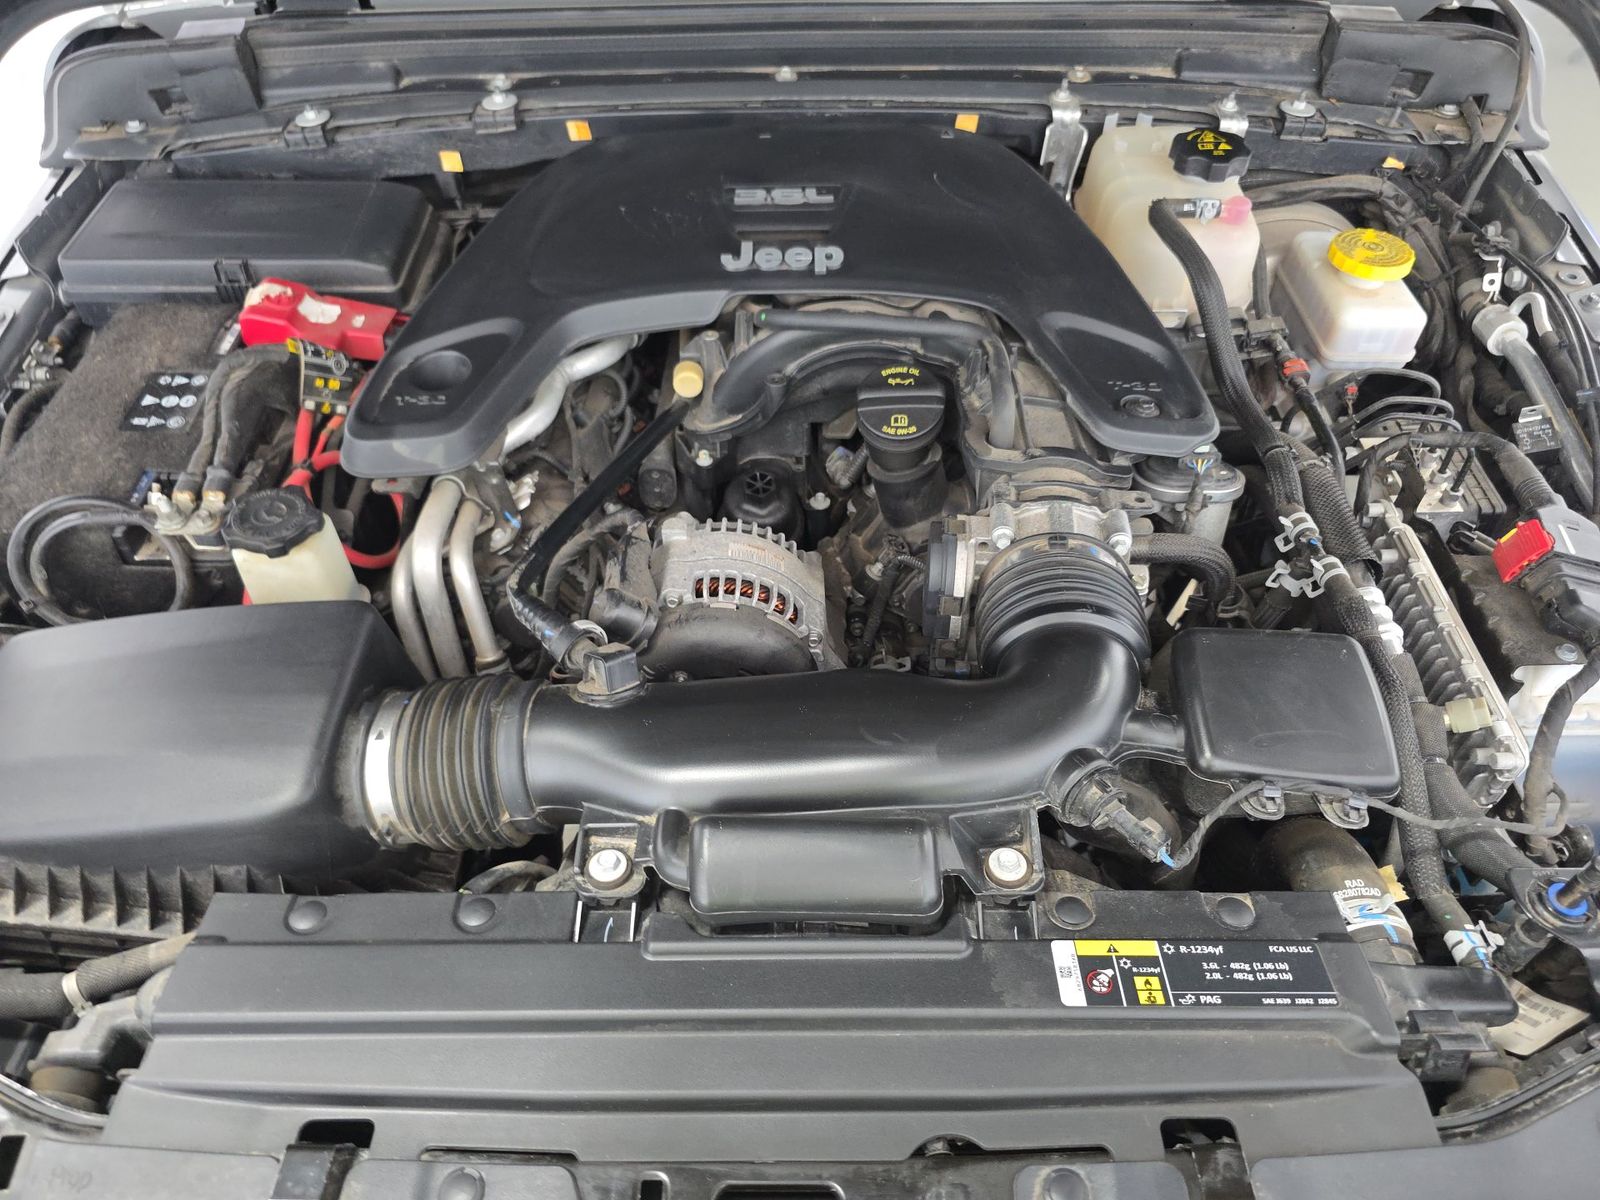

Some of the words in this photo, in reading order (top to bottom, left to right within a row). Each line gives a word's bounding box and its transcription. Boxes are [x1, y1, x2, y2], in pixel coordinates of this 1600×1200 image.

[720, 240, 845, 275] Jeep
[881, 366, 908, 377] ENGINE
[908, 367, 920, 377] OIL
[881, 425, 896, 435] SAE
[1344, 878, 1365, 888] RAD
[1179, 945, 1224, 956] R-1234yf
[1269, 945, 1287, 953] FCA
[1287, 945, 1299, 953] US
[1299, 945, 1314, 953] LLC
[1132, 966, 1161, 974] R-1234yf
[1202, 962, 1220, 970] 3.6L
[1229, 962, 1251, 971] 482g
[1252, 962, 1275, 971] (1.06
[1205, 972, 1224, 980] 2.0L
[1233, 972, 1254, 981] 482g
[1256, 972, 1279, 981] (1.06
[1199, 995, 1222, 1005] PAG
